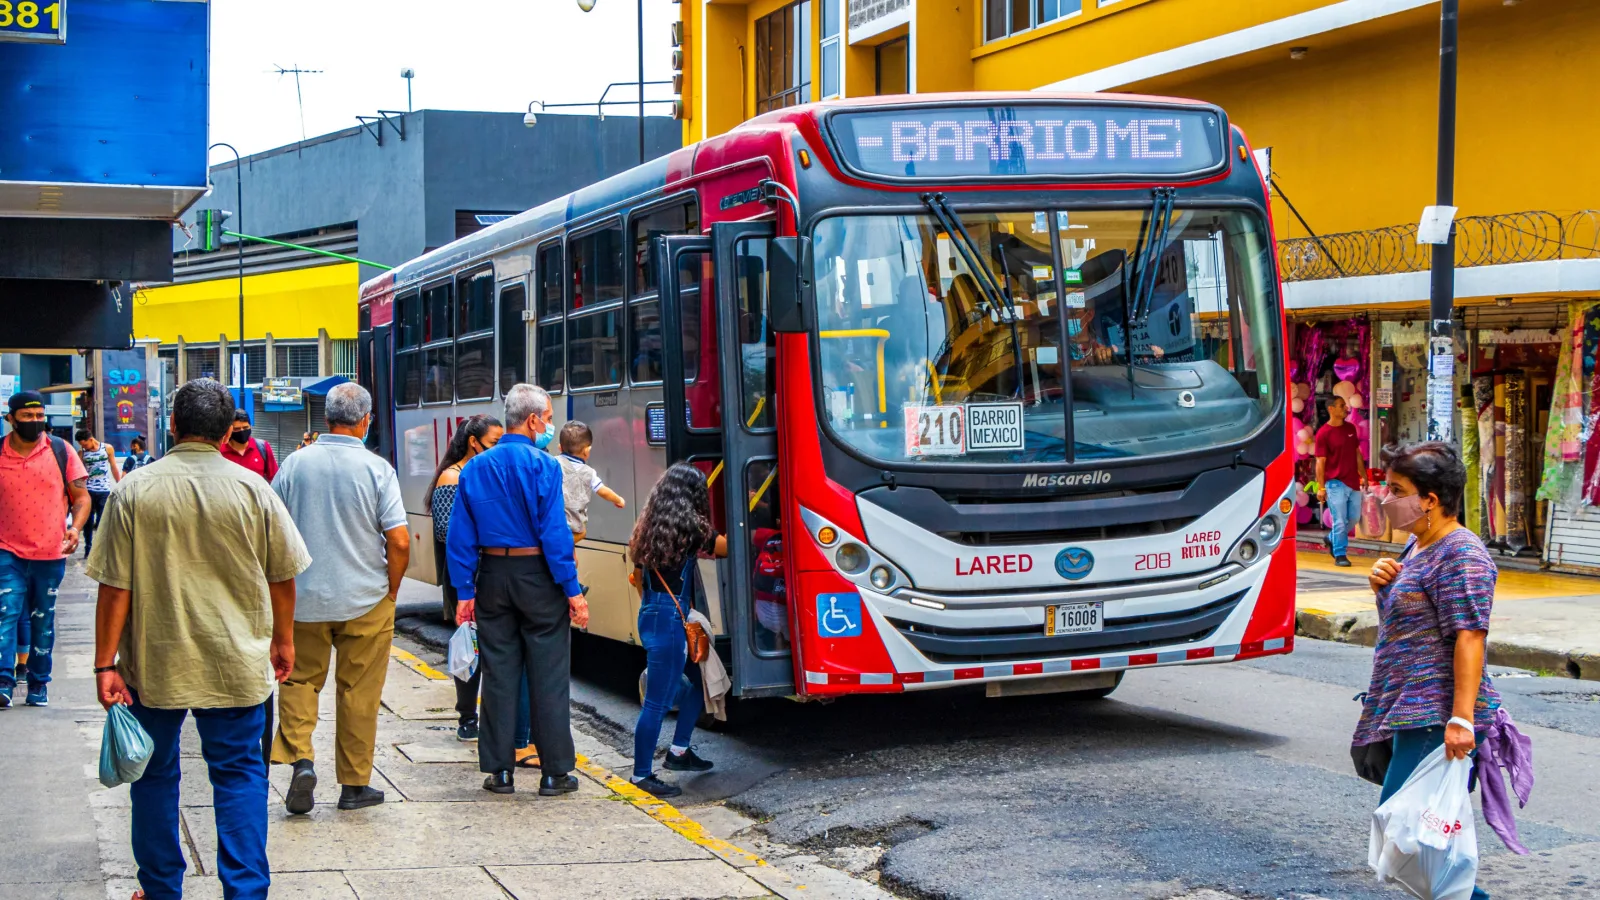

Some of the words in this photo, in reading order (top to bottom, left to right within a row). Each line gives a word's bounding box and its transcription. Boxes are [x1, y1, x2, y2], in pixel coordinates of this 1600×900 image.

[892, 120, 1097, 161] BARRIO
[973, 410, 1016, 426] BARRIO
[919, 412, 961, 446] 210
[973, 428, 1018, 444] MEXICO
[1022, 470, 1112, 488] Mascarello
[1185, 531, 1221, 544] LARED
[1181, 544, 1206, 559] RUTA
[1209, 543, 1220, 556] 16
[955, 553, 1033, 576] LARED
[1135, 552, 1171, 571] 208
[1061, 609, 1097, 627] 16008
